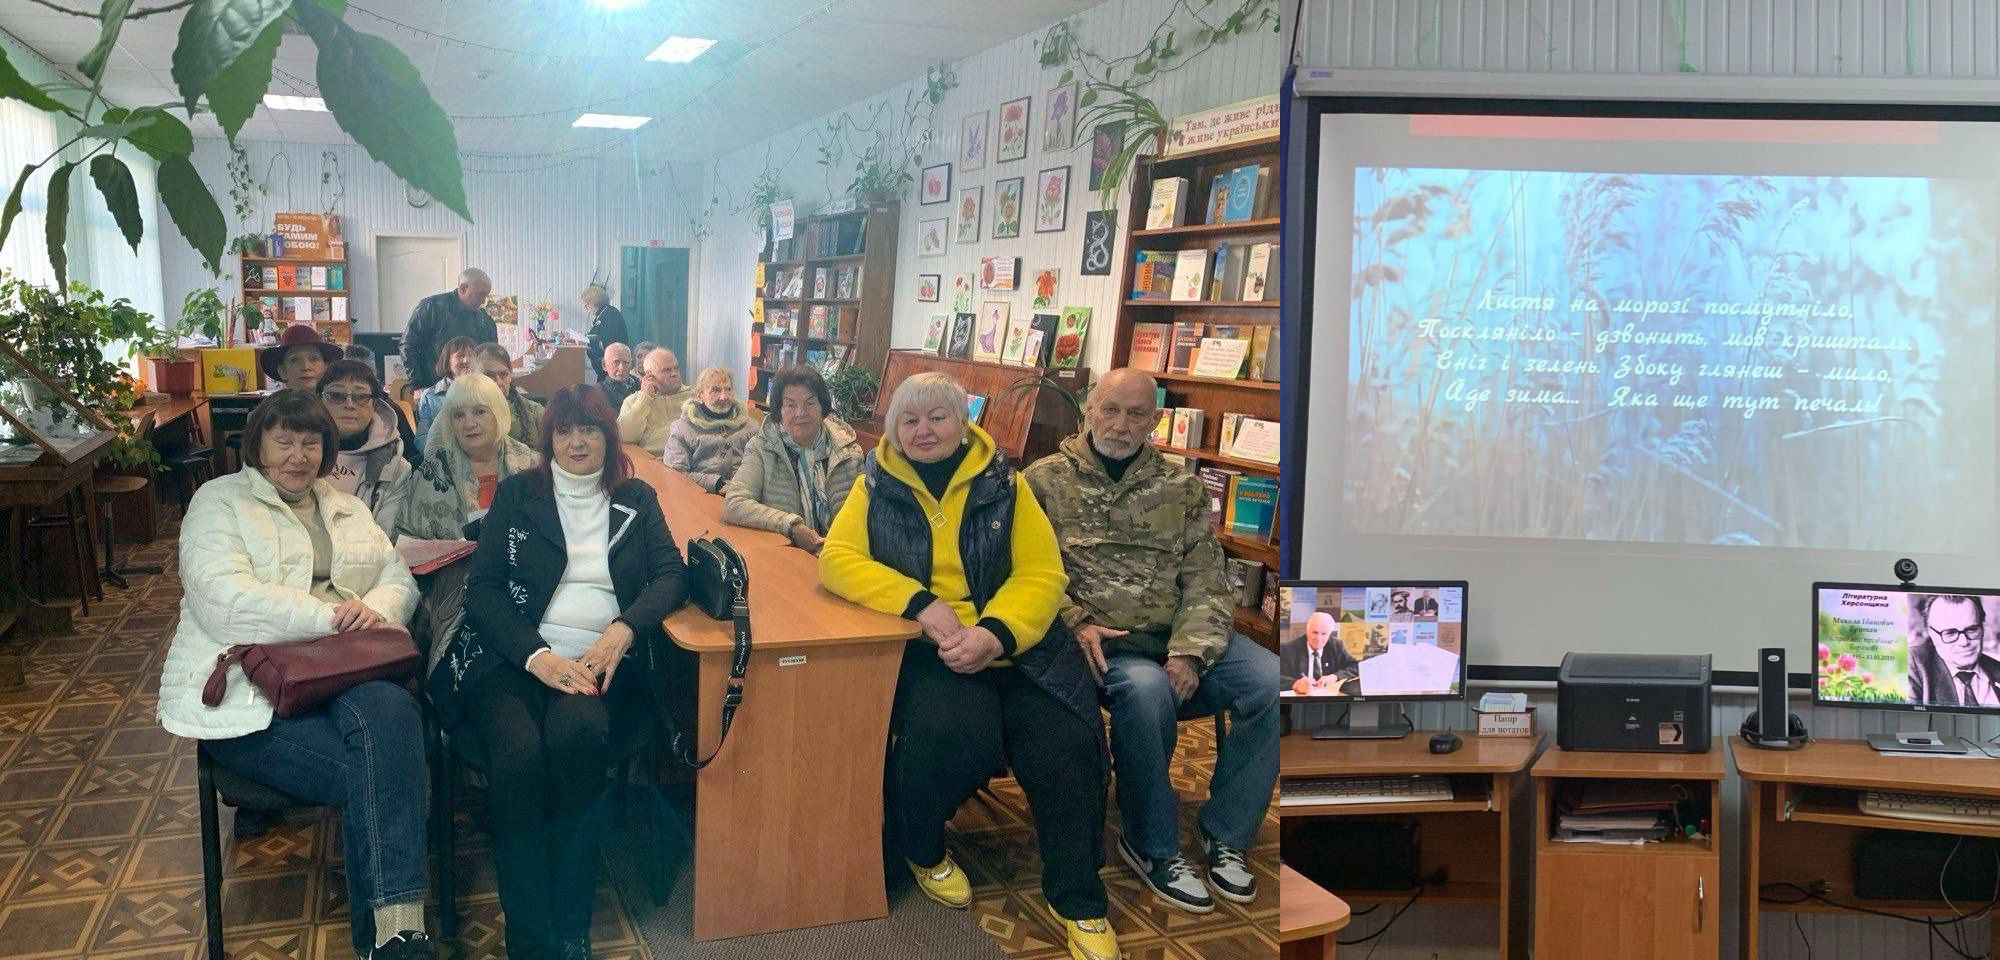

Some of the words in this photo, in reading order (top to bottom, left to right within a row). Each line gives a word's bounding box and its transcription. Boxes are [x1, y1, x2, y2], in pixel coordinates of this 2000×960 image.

[277, 223, 306, 232] БУДЬ
[278, 232, 318, 241] АМИМ
[1478, 289, 1555, 311] Листя
[1571, 297, 1599, 312] на
[1613, 298, 1690, 322] морозі
[1418, 318, 1556, 342] Поскляніло
[1723, 326, 1769, 347] мов
[1437, 350, 1488, 371] Сніг
[1613, 354, 1684, 386] Збоку
[1699, 364, 1784, 379] глянеш
[1608, 386, 1659, 407] Яка
[1673, 394, 1709, 410] ще
[1722, 394, 1781, 419] тут
[1842, 593, 1888, 601] Літературна
[1841, 600, 1889, 608] Херсонщина
[1494, 715, 1518, 724] Папір
